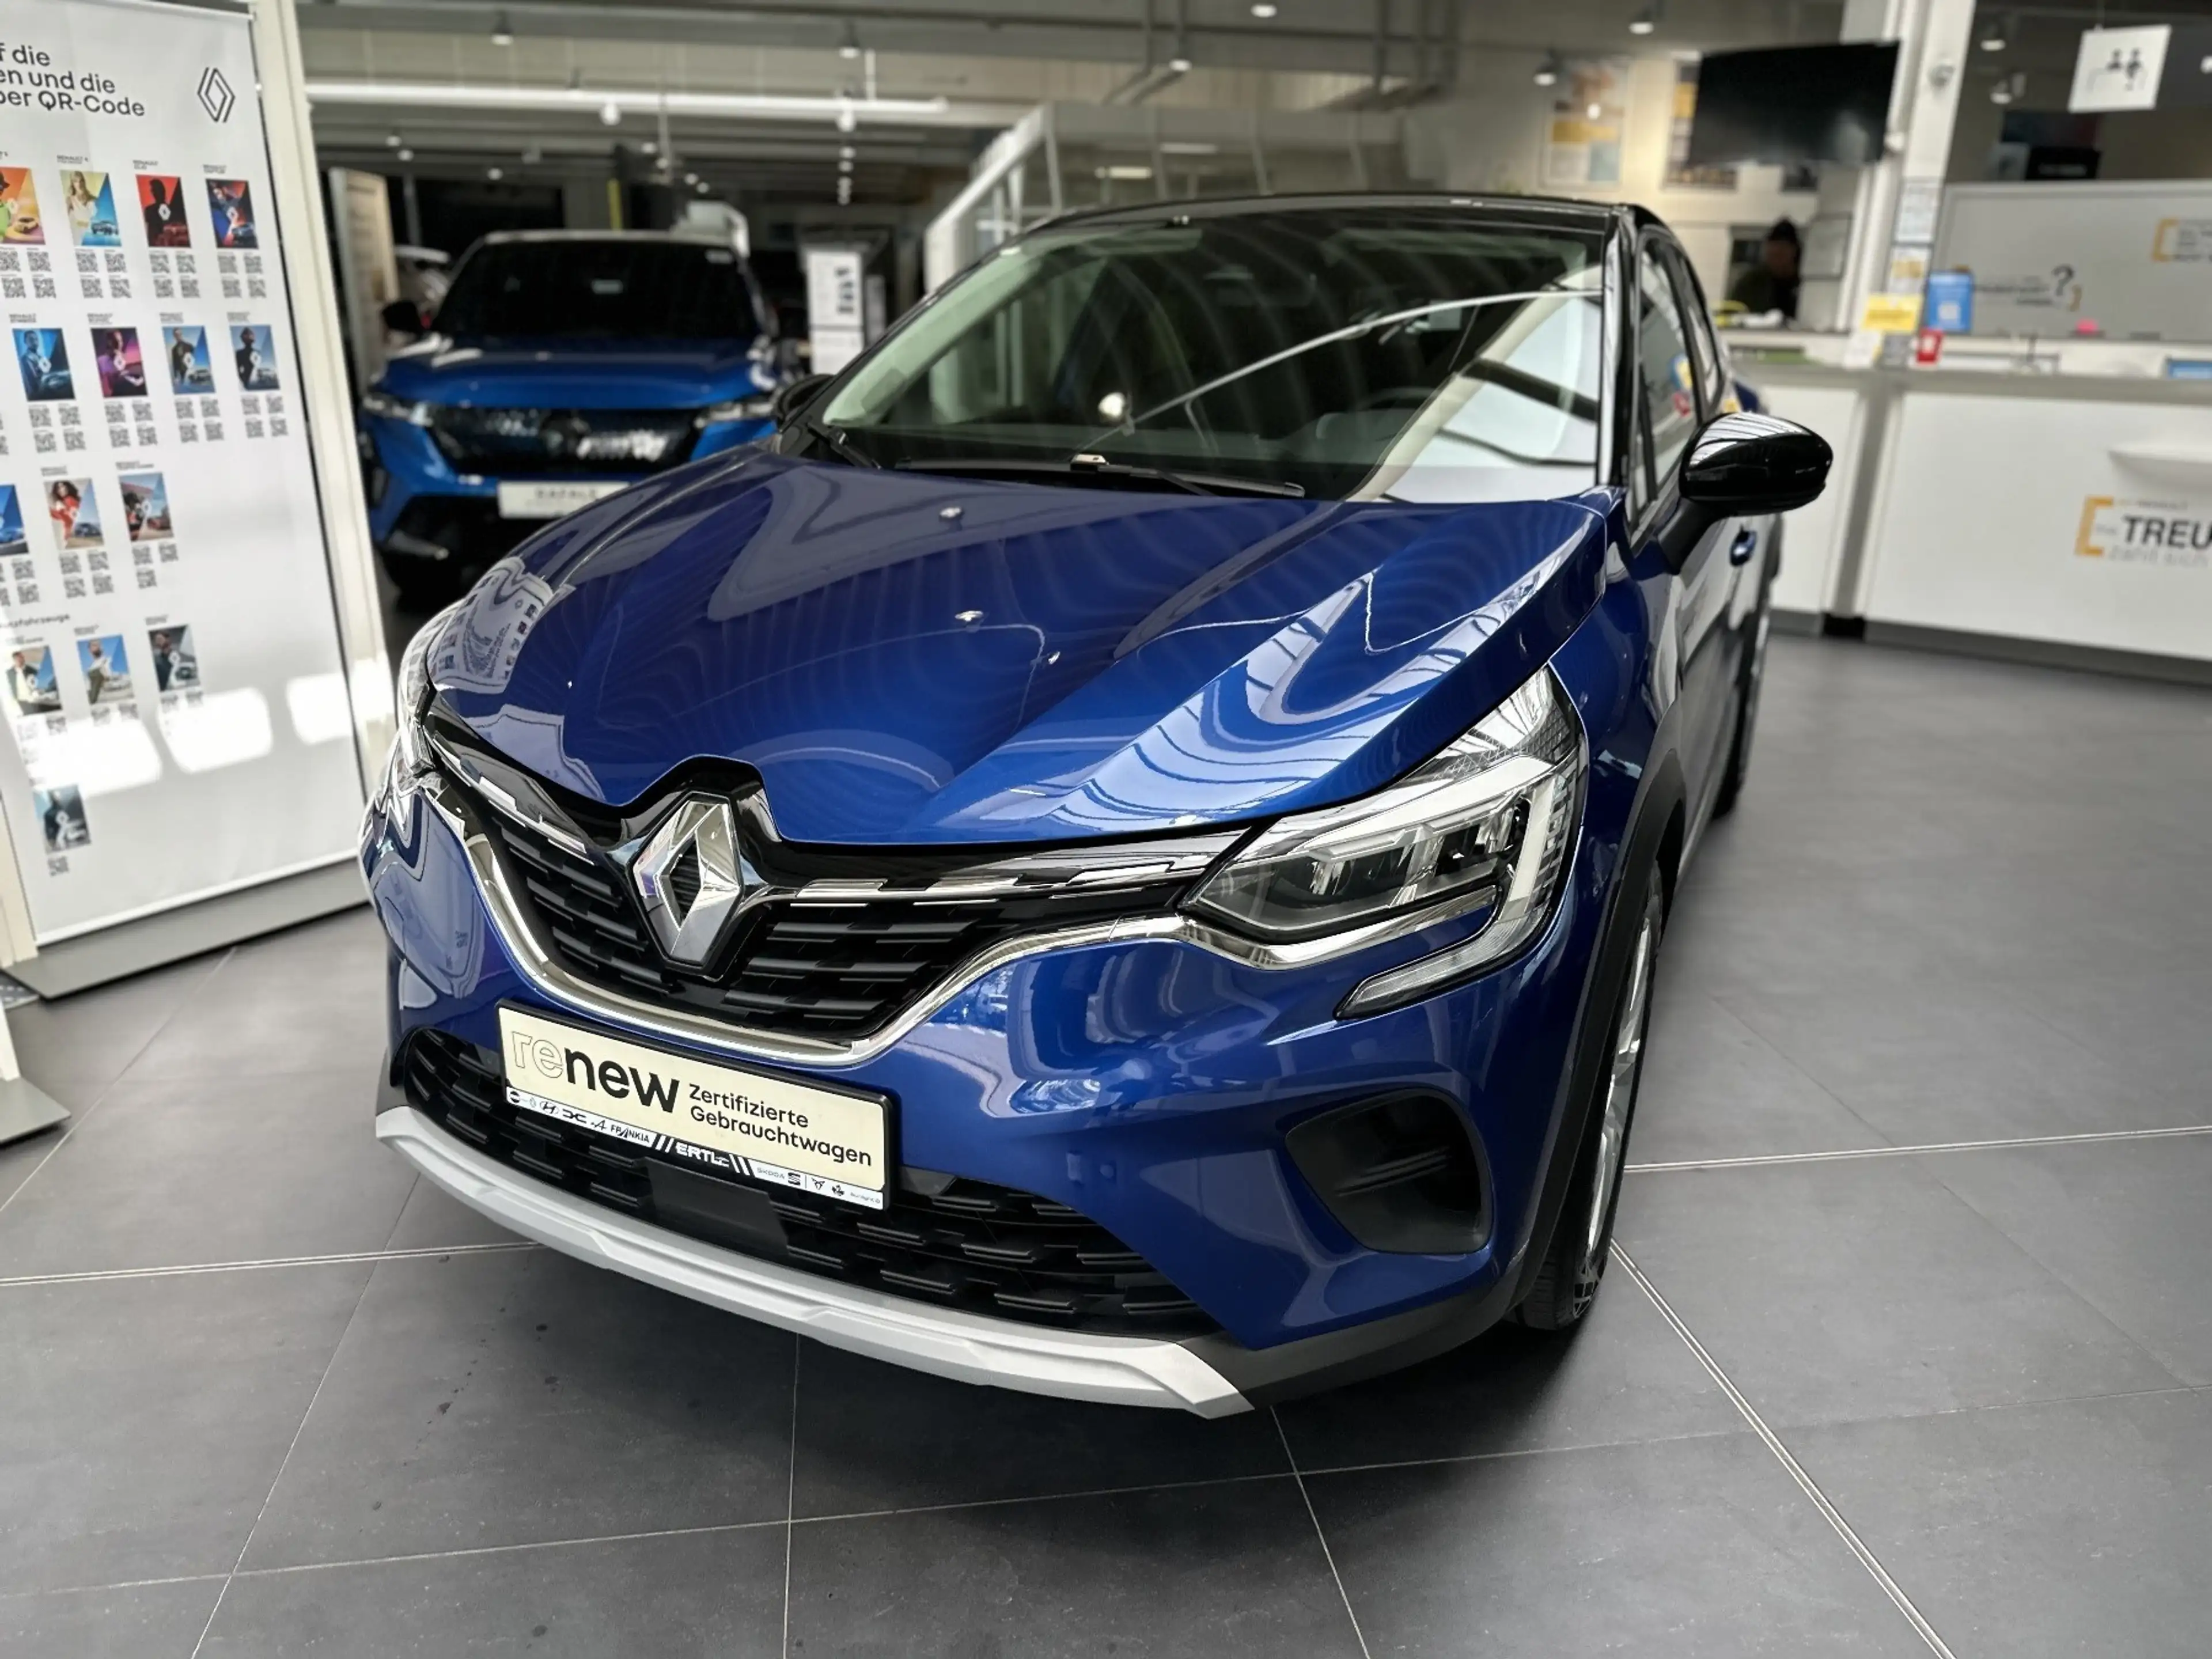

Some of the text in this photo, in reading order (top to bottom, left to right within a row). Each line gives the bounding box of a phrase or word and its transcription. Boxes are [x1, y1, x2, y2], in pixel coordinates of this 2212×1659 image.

[12, 44, 51, 66] die
[28, 71, 74, 89] und
[80, 73, 116, 93] die
[38, 90, 145, 116] QR-Code
[512, 1031, 680, 1113] renew
[689, 1083, 808, 1128] Zertifizierte
[611, 1124, 650, 1143] FRANKIA
[691, 1105, 872, 1166] Gebrauchtwagen
